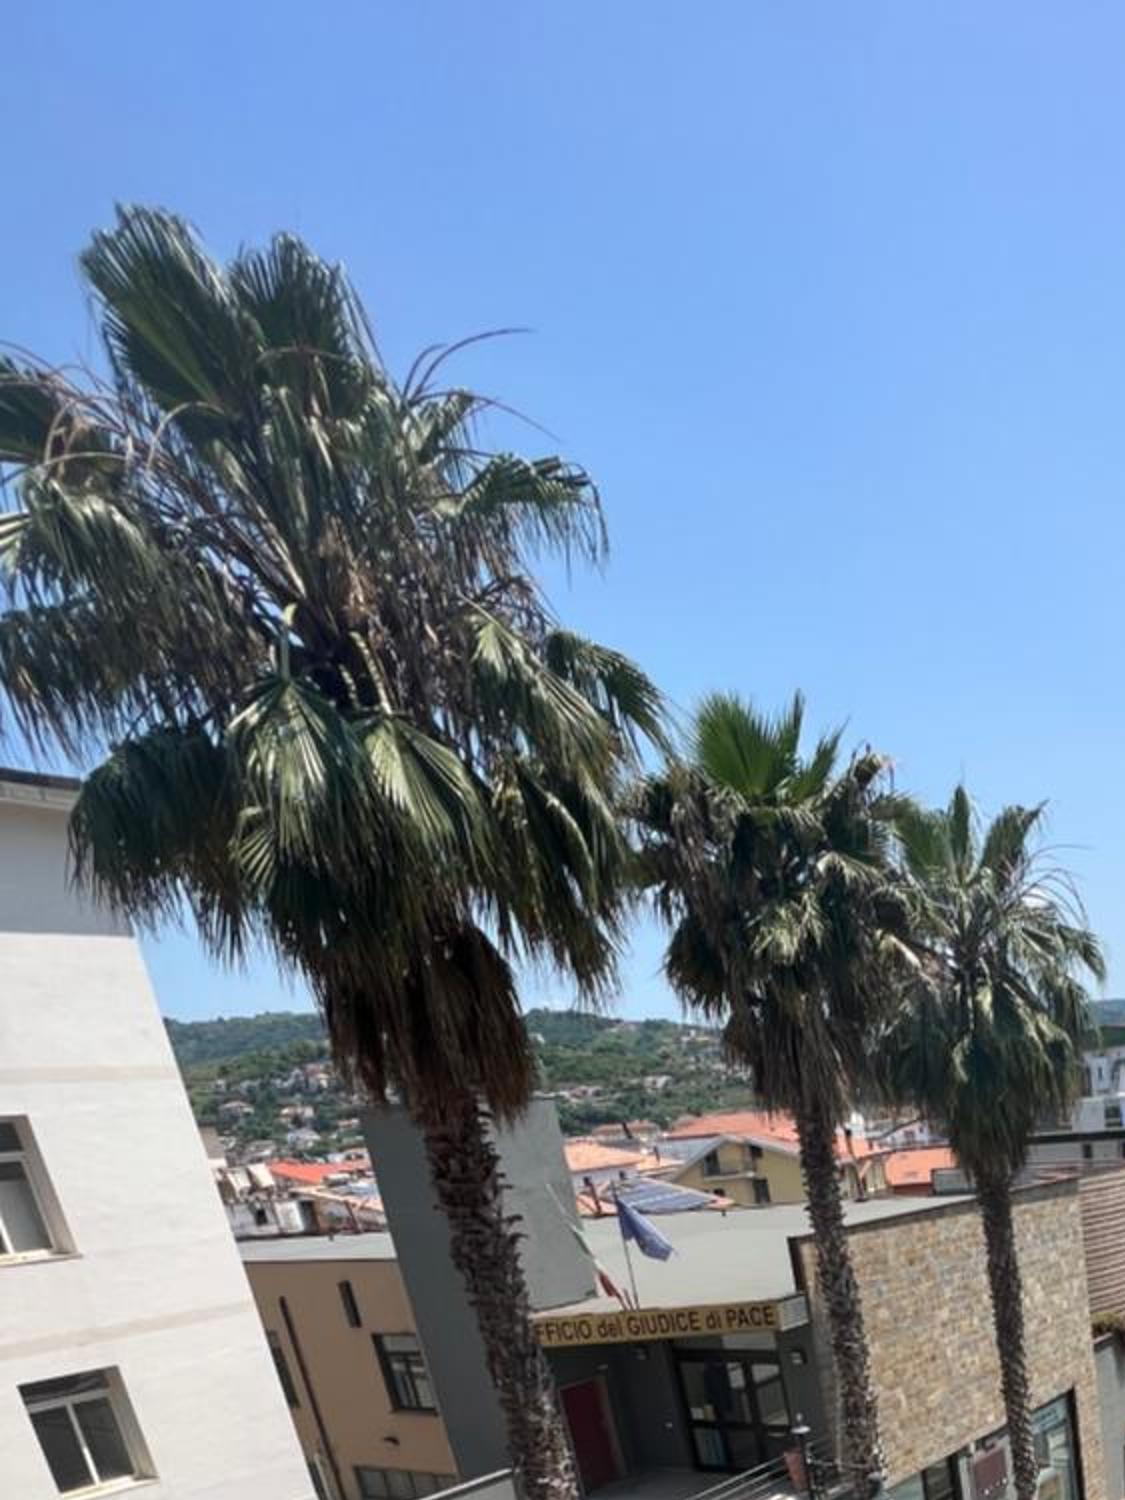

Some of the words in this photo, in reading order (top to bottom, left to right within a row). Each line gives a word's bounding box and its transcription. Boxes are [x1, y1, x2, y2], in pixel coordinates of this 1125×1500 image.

[535, 1319, 593, 1342] FFICIO
[598, 1317, 624, 1338] del
[626, 1311, 702, 1336] GIUDICE
[706, 1311, 722, 1329] di
[725, 1304, 775, 1328] PACE
